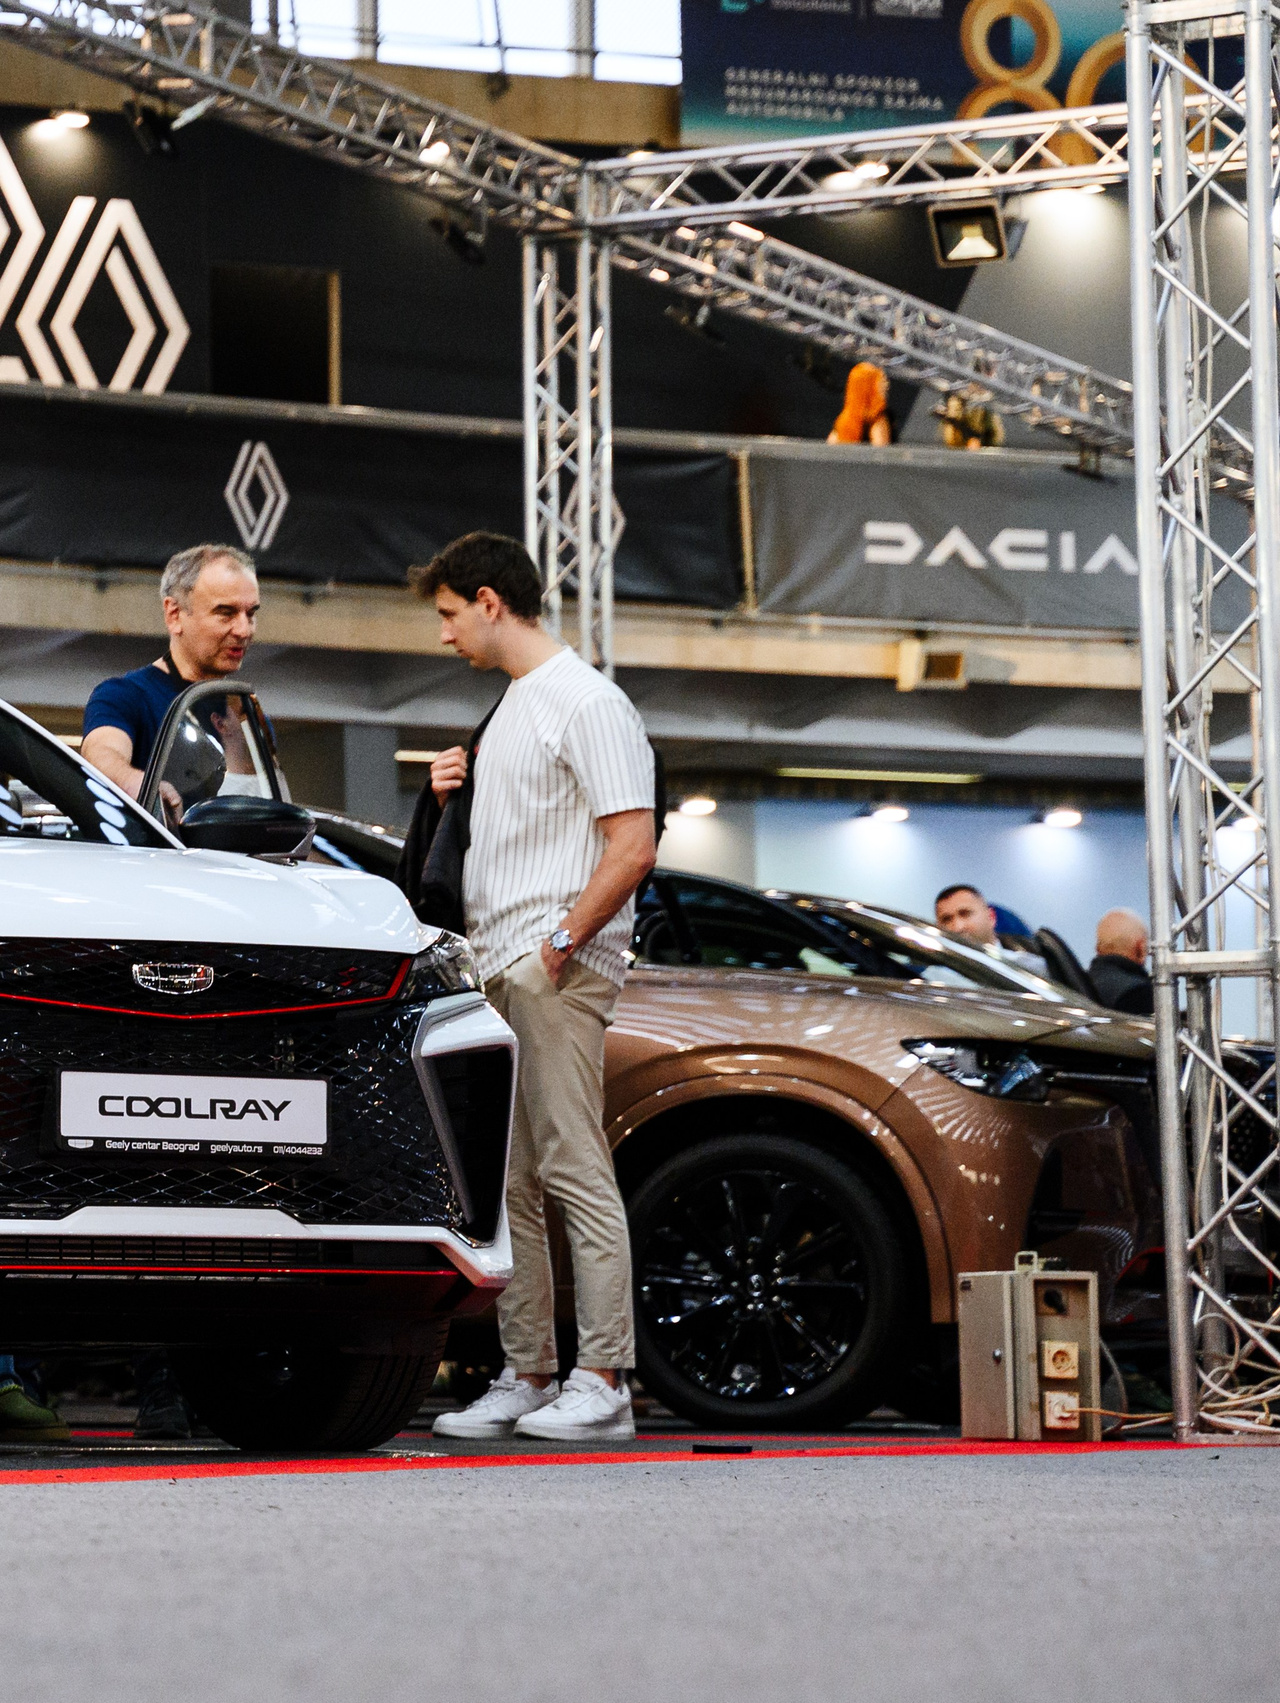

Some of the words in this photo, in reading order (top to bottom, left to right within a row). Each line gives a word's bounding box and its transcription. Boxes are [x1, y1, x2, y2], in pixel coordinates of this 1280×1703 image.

[864, 520, 1140, 576] DACIA
[98, 1095, 292, 1121] COOLRAY
[105, 1140, 130, 1151] Geely
[131, 1141, 160, 1151] centar
[161, 1141, 200, 1153] Beograd
[210, 1143, 263, 1154] geelyauto.rs
